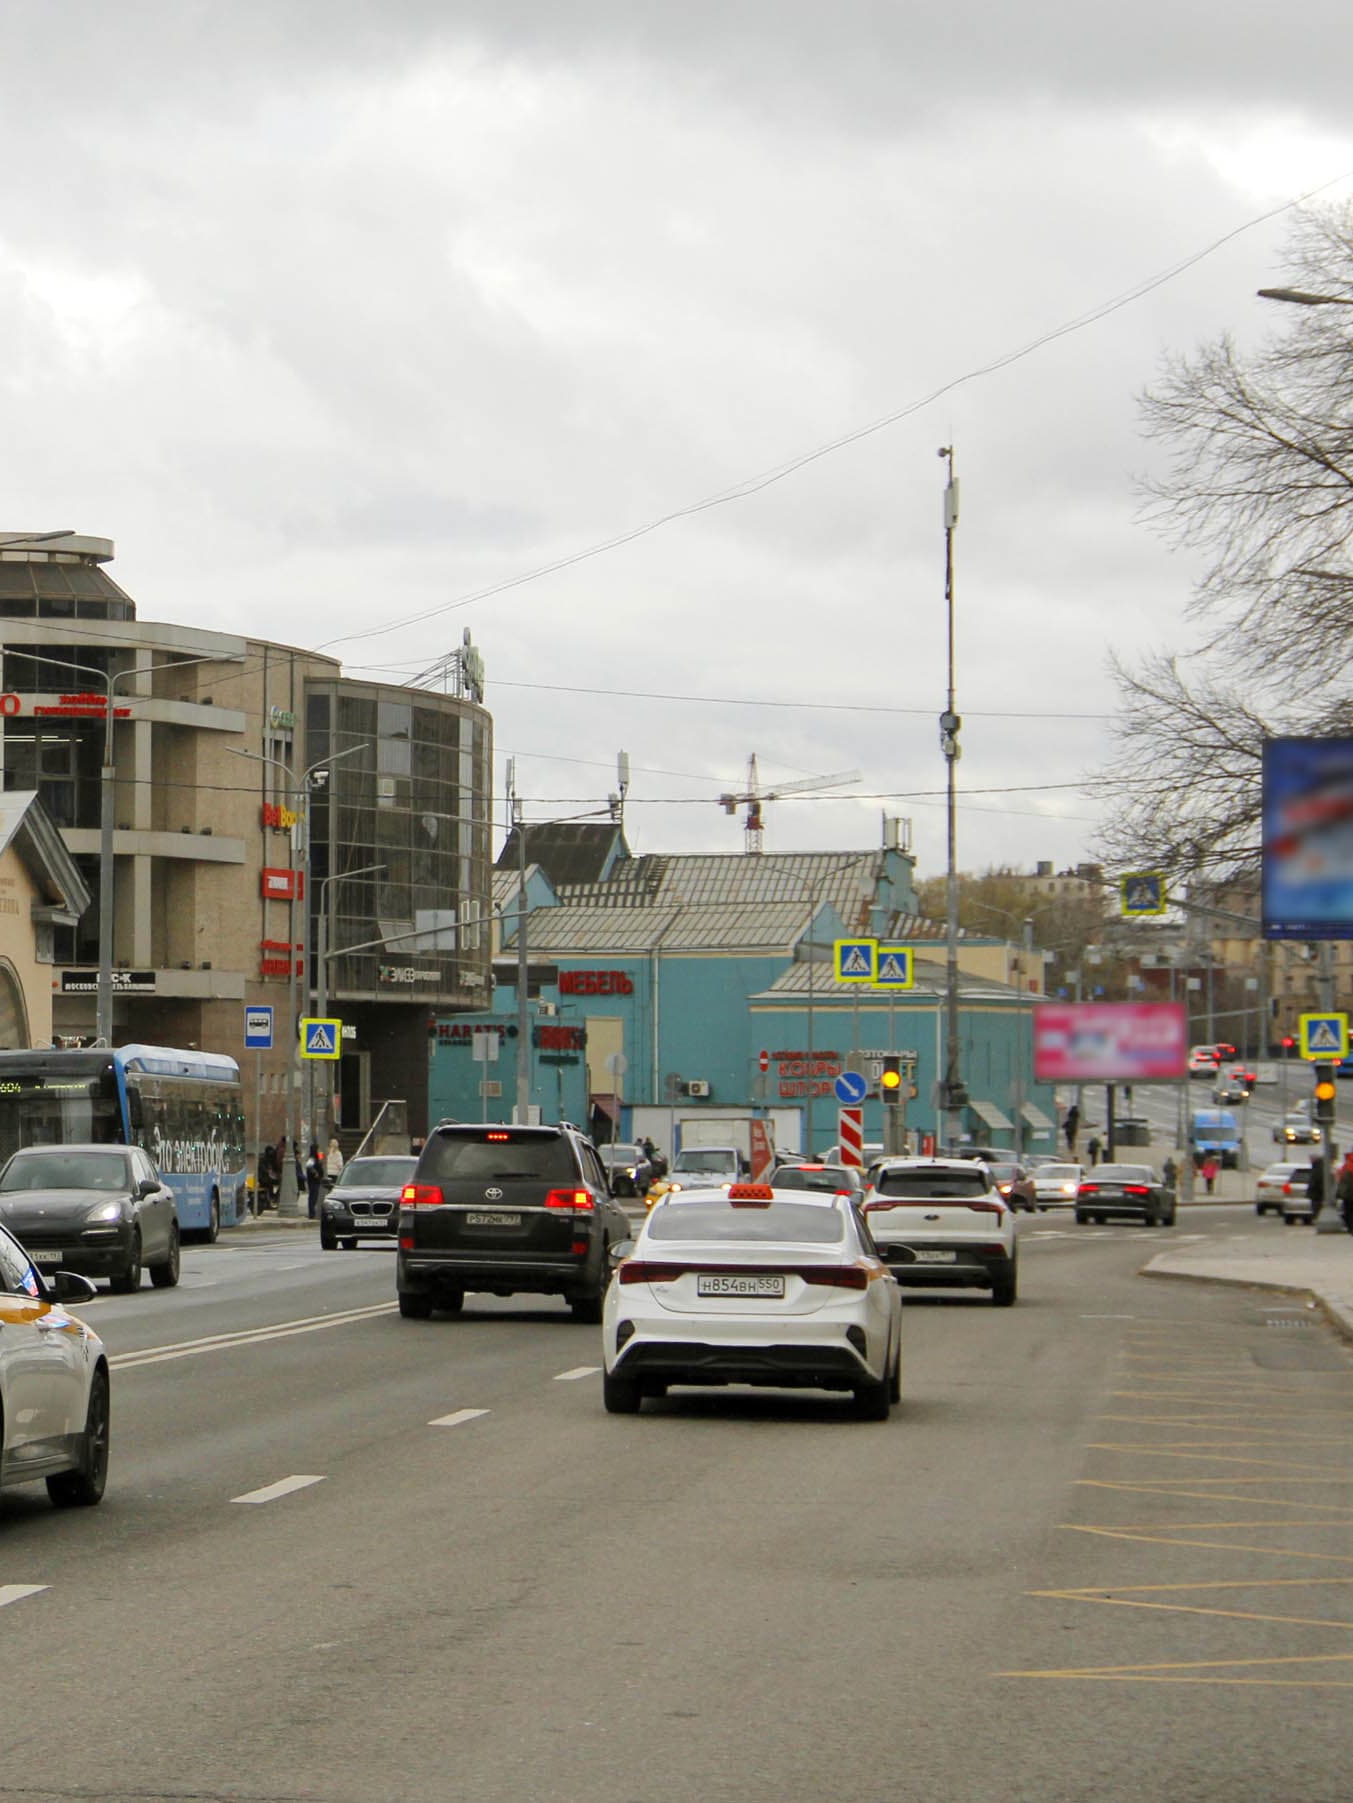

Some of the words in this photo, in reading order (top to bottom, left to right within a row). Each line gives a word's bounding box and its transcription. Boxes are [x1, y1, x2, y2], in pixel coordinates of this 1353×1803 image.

[558, 971, 634, 995] МЕБЕЛЬ
[0, 1083, 21, 1093] 604
[778, 1081, 836, 1098] ШТОР
[703, 1279, 756, 1292] Н854ВН
[759, 1279, 780, 1289] 550
